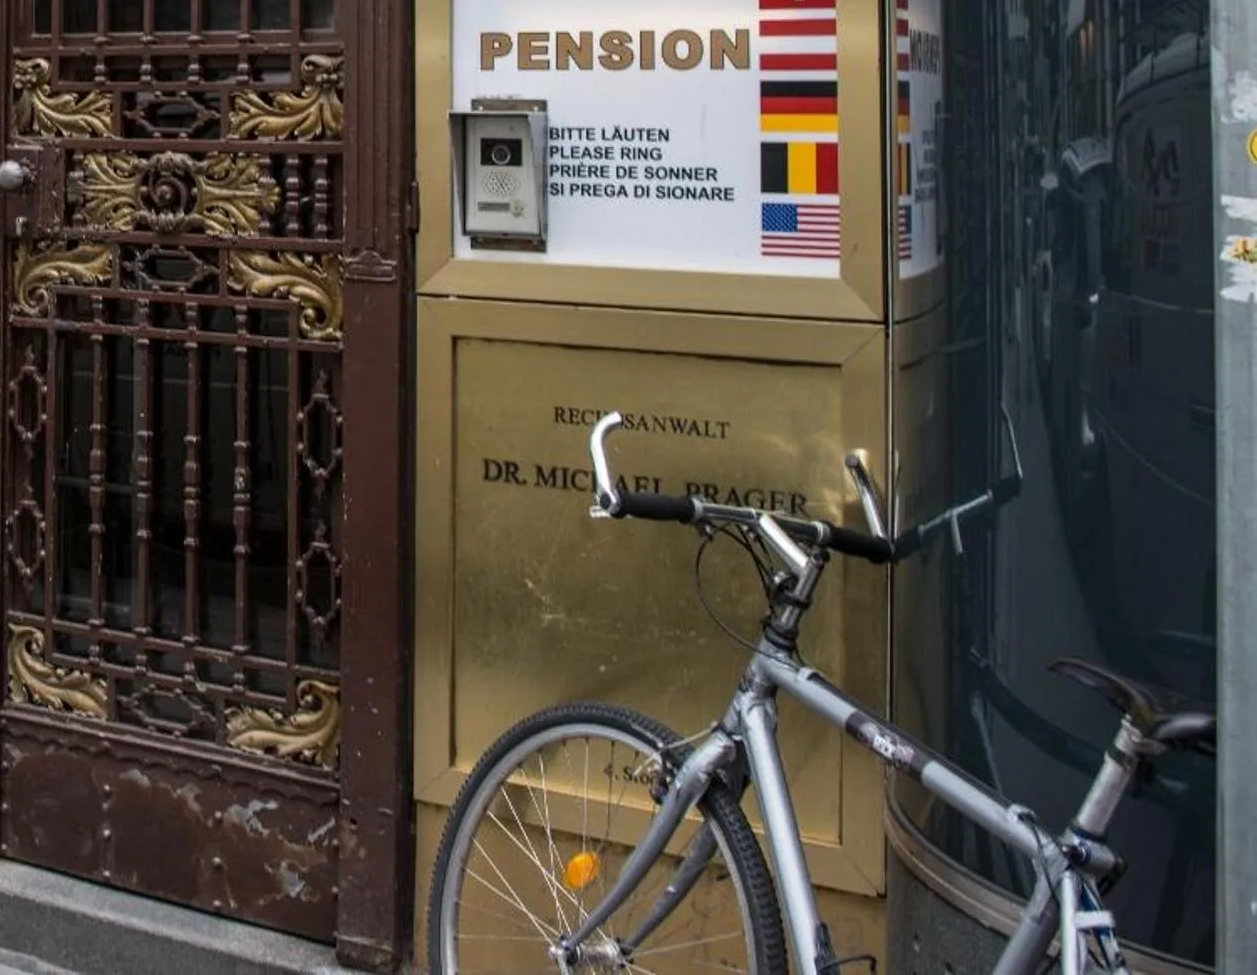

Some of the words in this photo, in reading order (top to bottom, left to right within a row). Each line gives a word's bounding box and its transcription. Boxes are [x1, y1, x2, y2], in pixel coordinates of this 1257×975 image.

[480, 29, 750, 71] PENSION
[549, 127, 596, 141] BITTE
[601, 125, 670, 142] LÄUTEN
[549, 146, 614, 160] PLEASE
[620, 146, 662, 161] RING
[616, 166, 638, 179] DE
[644, 166, 718, 182] SONNER
[549, 183, 564, 196] SI
[569, 183, 628, 198] PREGA
[633, 185, 650, 199] DI
[656, 186, 735, 201] SIONARE
[554, 406, 730, 439] RECSANWALT
[483, 458, 526, 485] DR.
